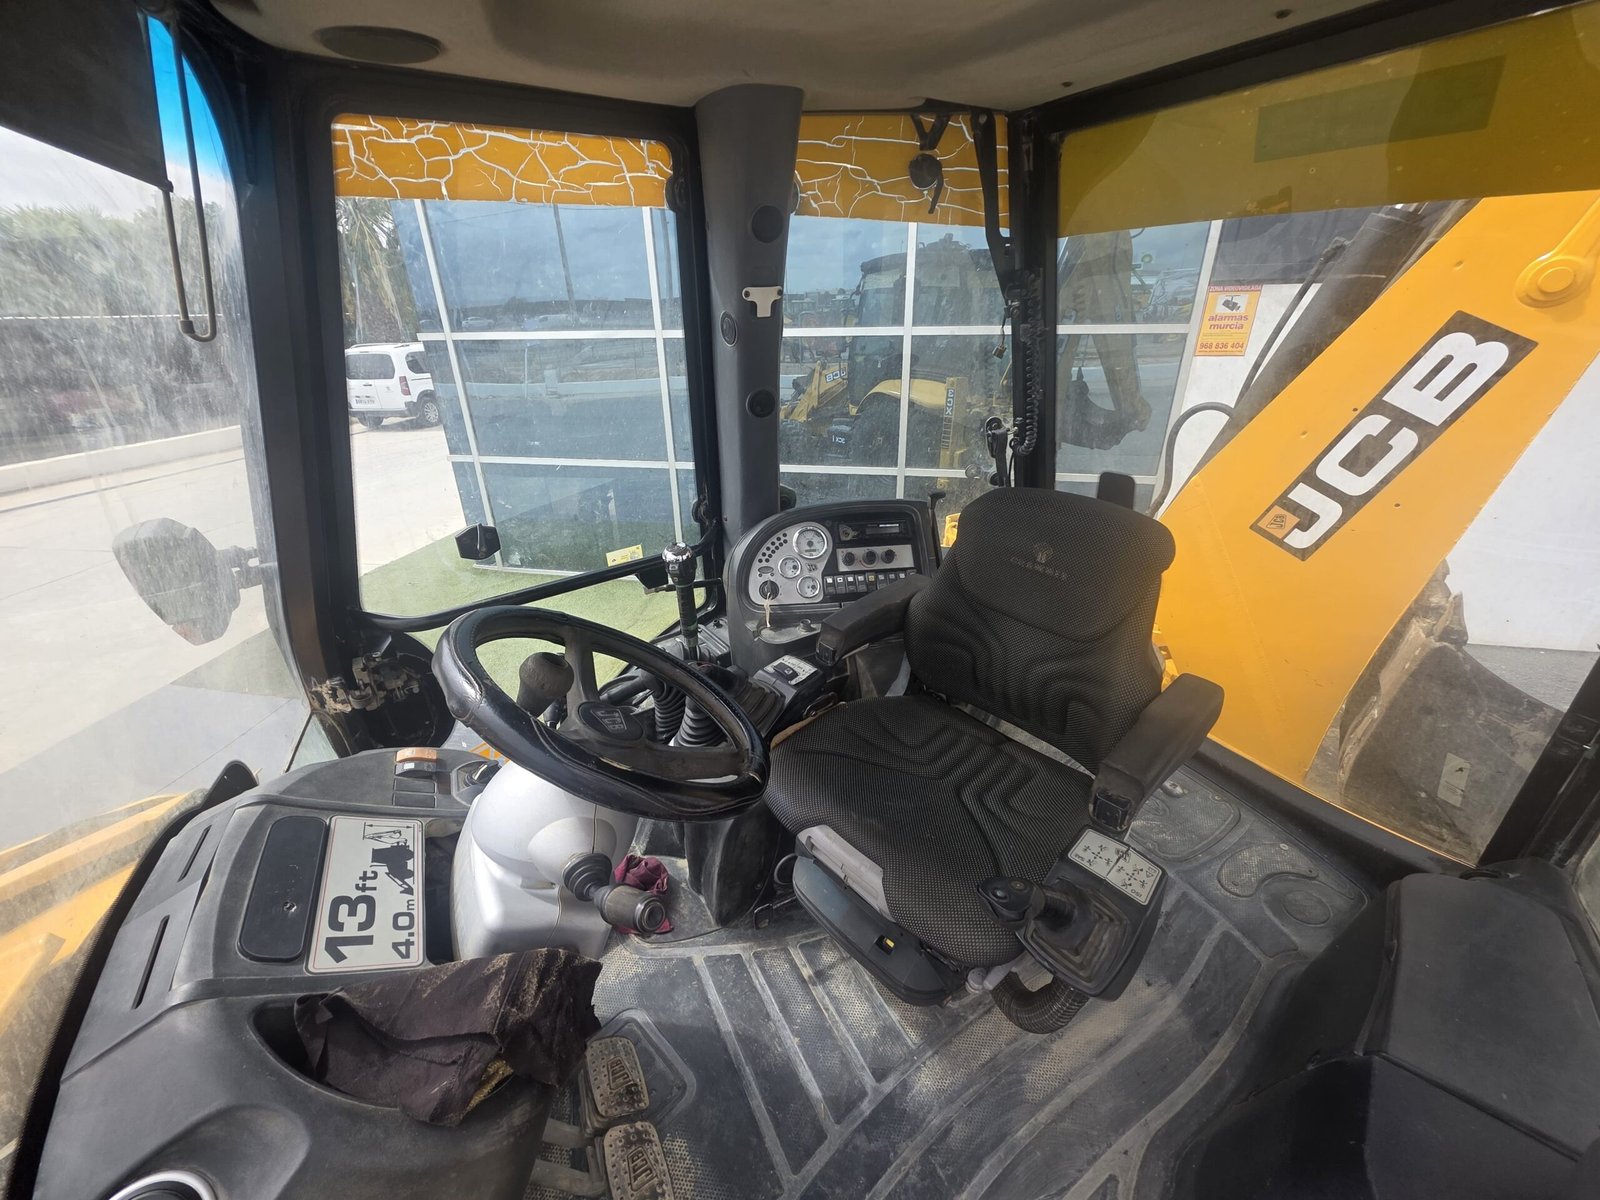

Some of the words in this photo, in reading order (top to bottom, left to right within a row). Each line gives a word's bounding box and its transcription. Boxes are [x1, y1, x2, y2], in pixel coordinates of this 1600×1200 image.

[1208, 314, 1249, 322] alarmas
[1209, 322, 1244, 330] murcia
[1199, 342, 1214, 350] 968
[1215, 342, 1229, 350] 836
[1230, 342, 1245, 350] 404
[1283, 332, 1509, 549] JCB
[596, 710, 624, 730] JCB
[631, 1150, 656, 1185] JCB
